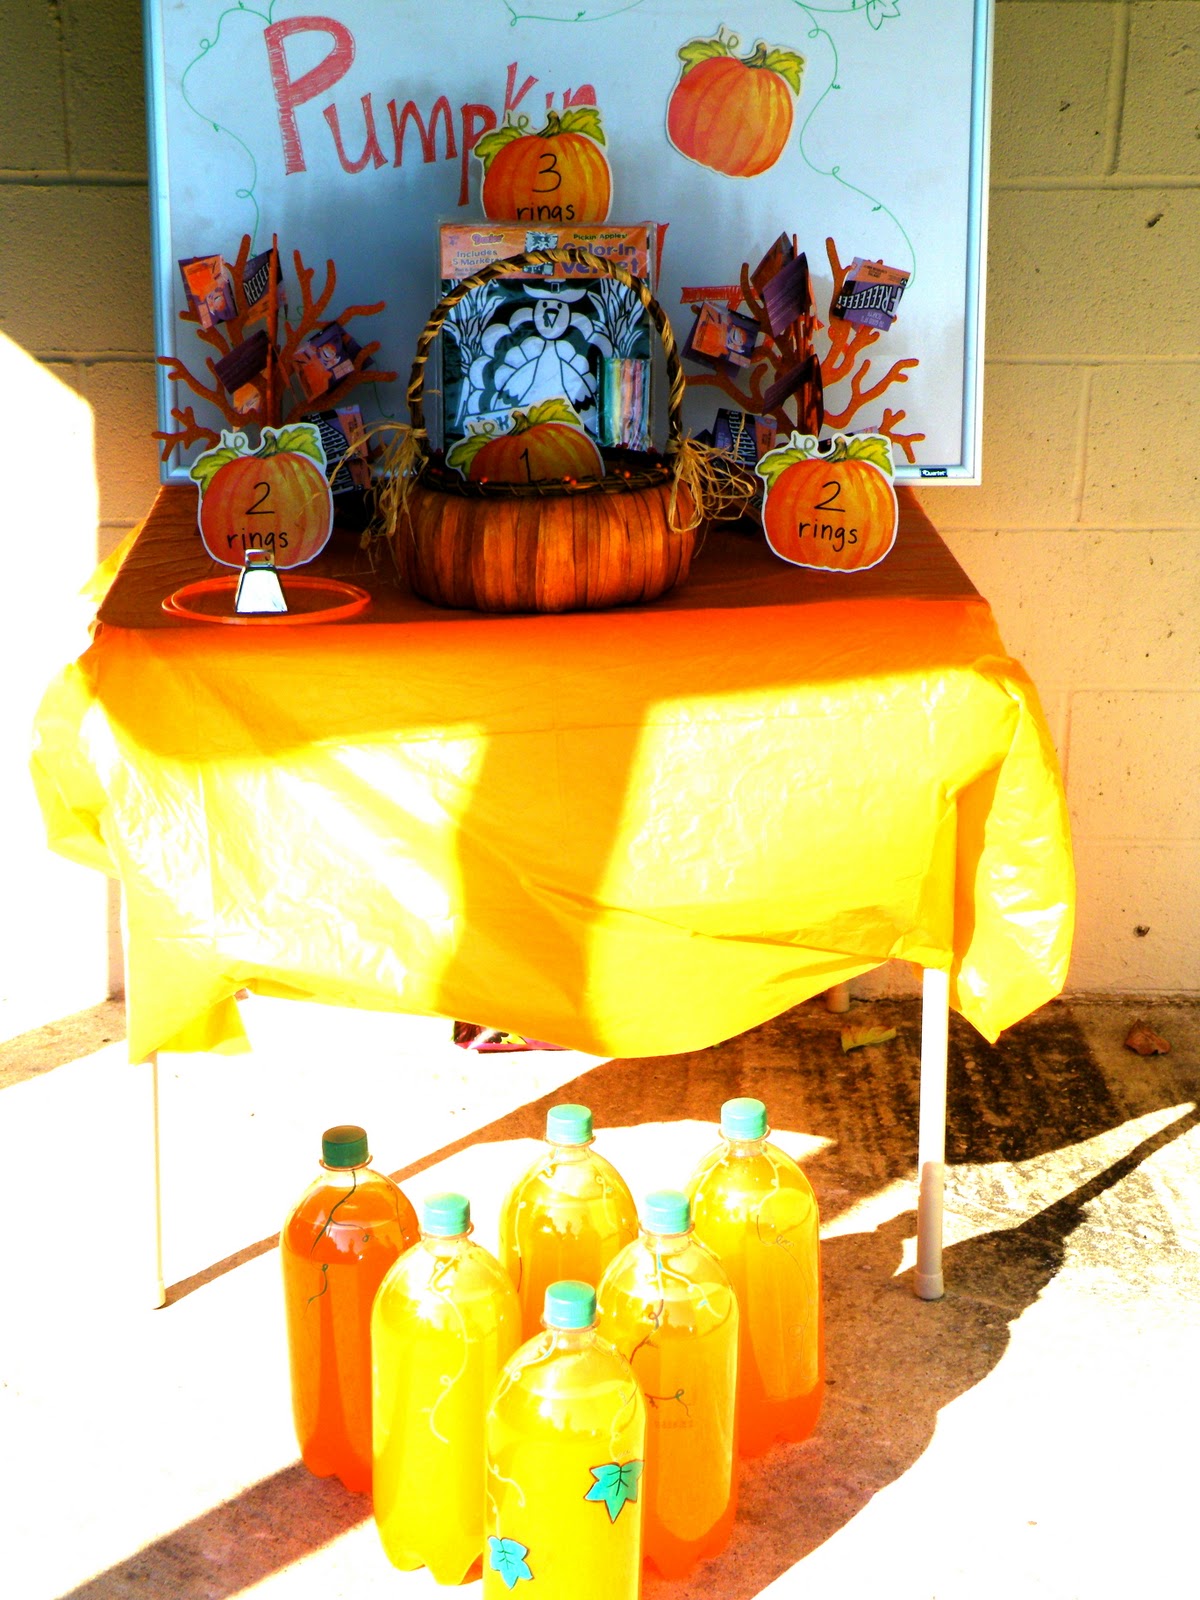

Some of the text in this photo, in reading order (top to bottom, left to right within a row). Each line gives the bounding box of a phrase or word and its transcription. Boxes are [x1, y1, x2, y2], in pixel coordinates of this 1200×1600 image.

[532, 153, 561, 193] 3
[456, 248, 498, 258] Includes
[520, 447, 531, 483] 1
[246, 481, 276, 516] 2
[813, 481, 847, 513] 2
[226, 527, 289, 560] rings
[798, 519, 858, 552] rings
